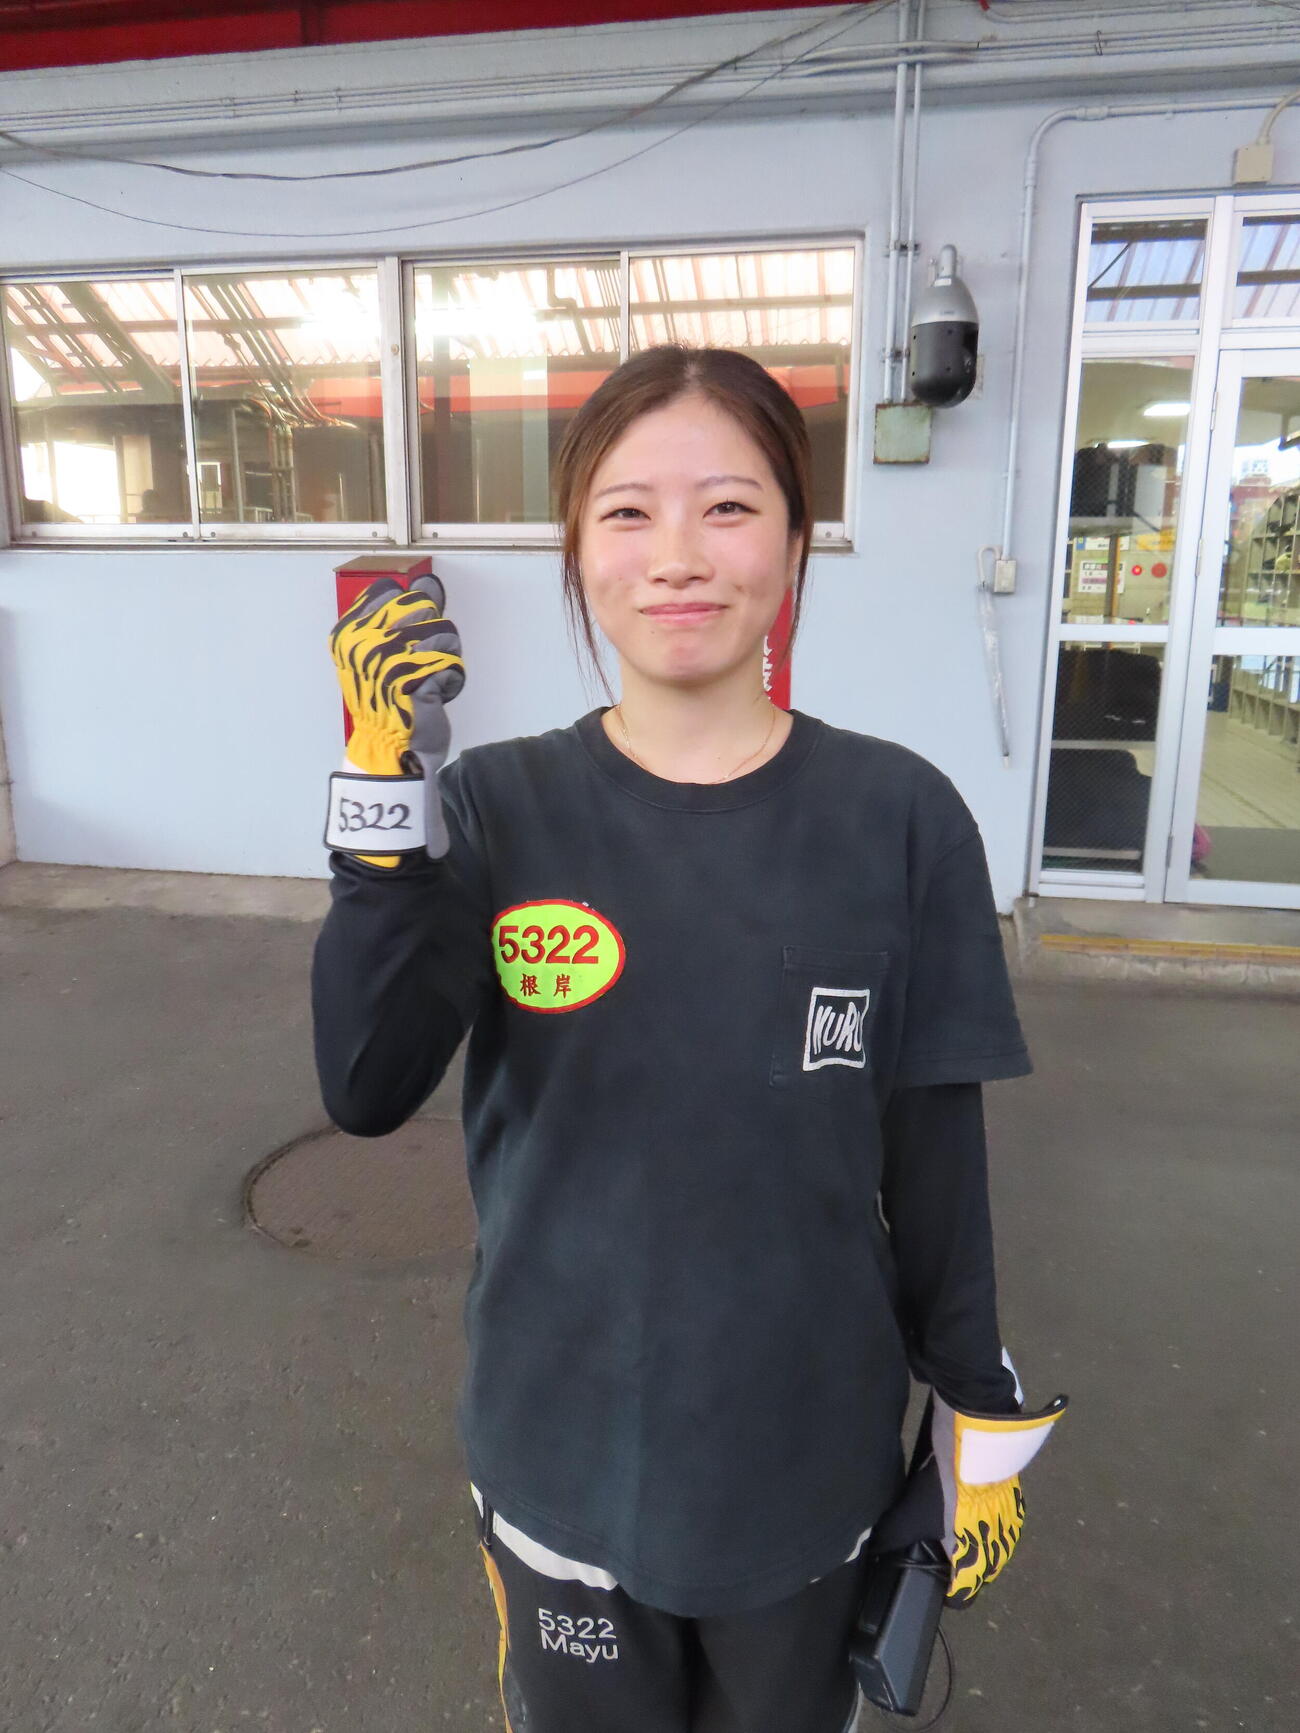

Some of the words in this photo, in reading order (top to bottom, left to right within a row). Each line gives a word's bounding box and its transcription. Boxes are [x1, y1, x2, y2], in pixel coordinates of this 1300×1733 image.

[339, 796, 412, 832] 5322
[498, 924, 600, 964] 5322
[519, 973, 572, 999] 根岸
[538, 1607, 617, 1639] 5322
[540, 1628, 619, 1663] Mayu
